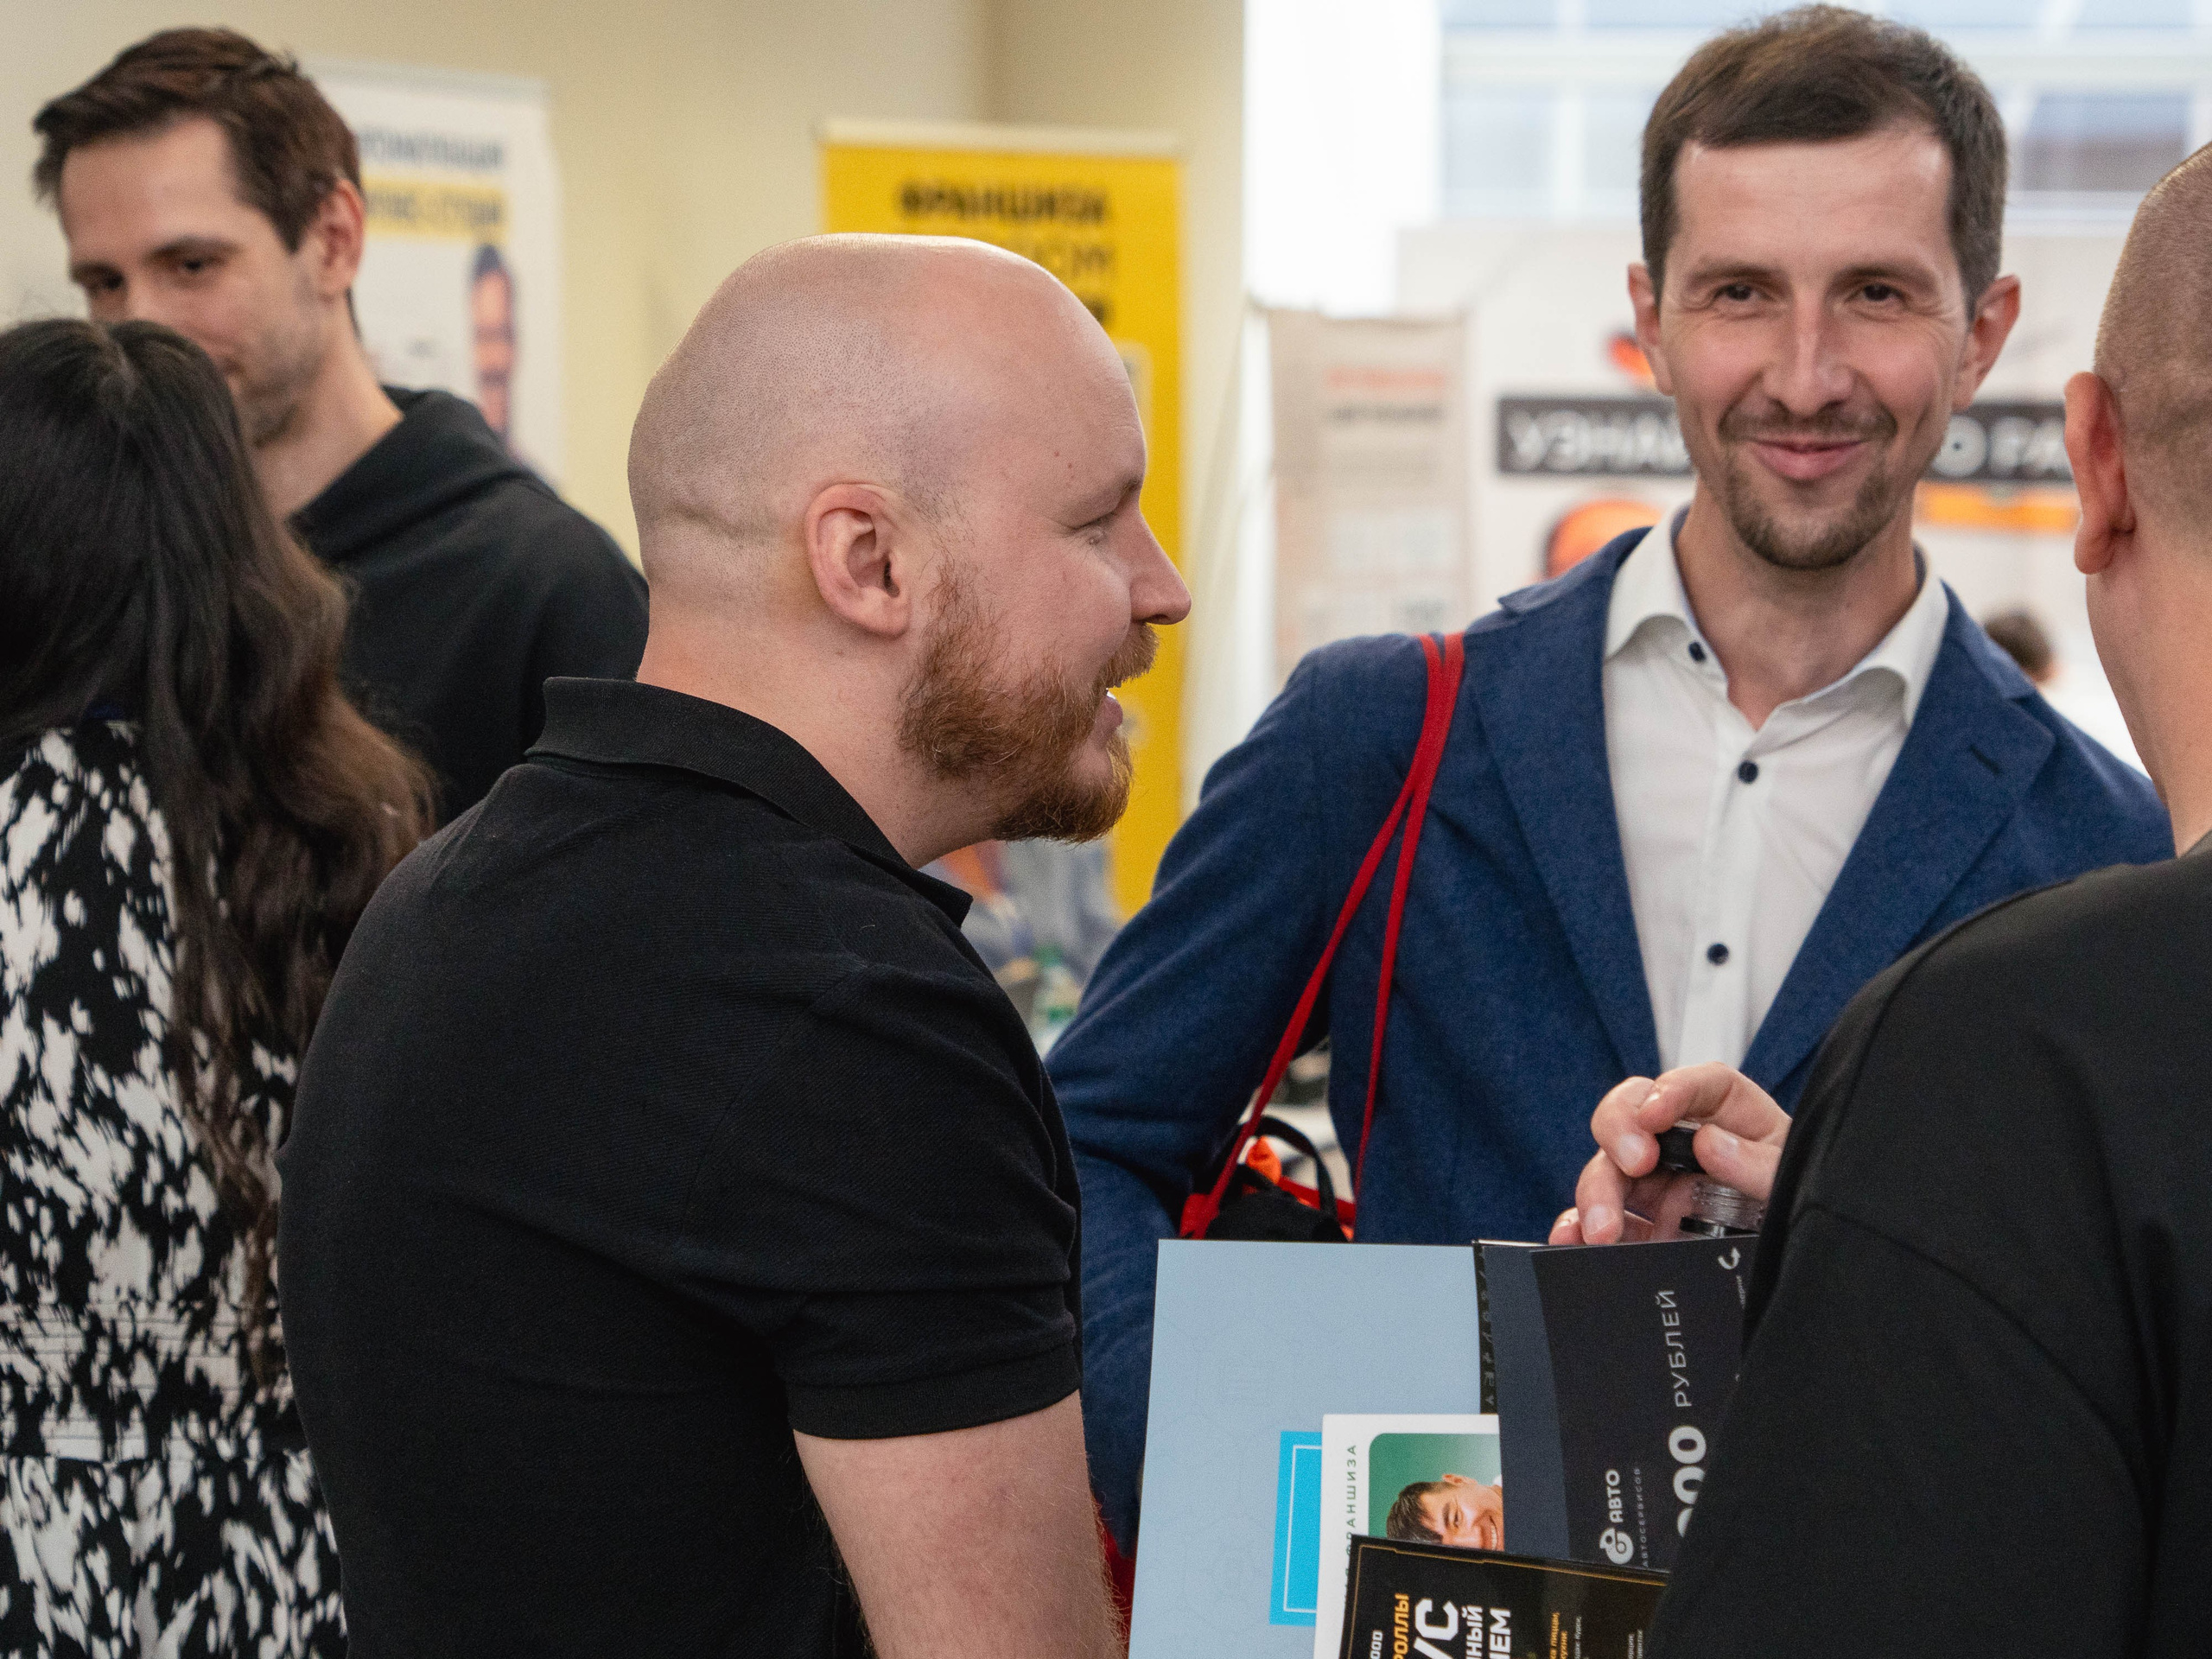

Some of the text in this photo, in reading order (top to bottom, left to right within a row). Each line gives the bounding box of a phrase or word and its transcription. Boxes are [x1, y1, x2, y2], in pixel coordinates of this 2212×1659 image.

[1654, 1289, 1707, 1538] 00 РУБЛЕЙ
[1605, 1469, 1624, 1523] АВТО
[1461, 1605, 1484, 1659] НЫЙ
